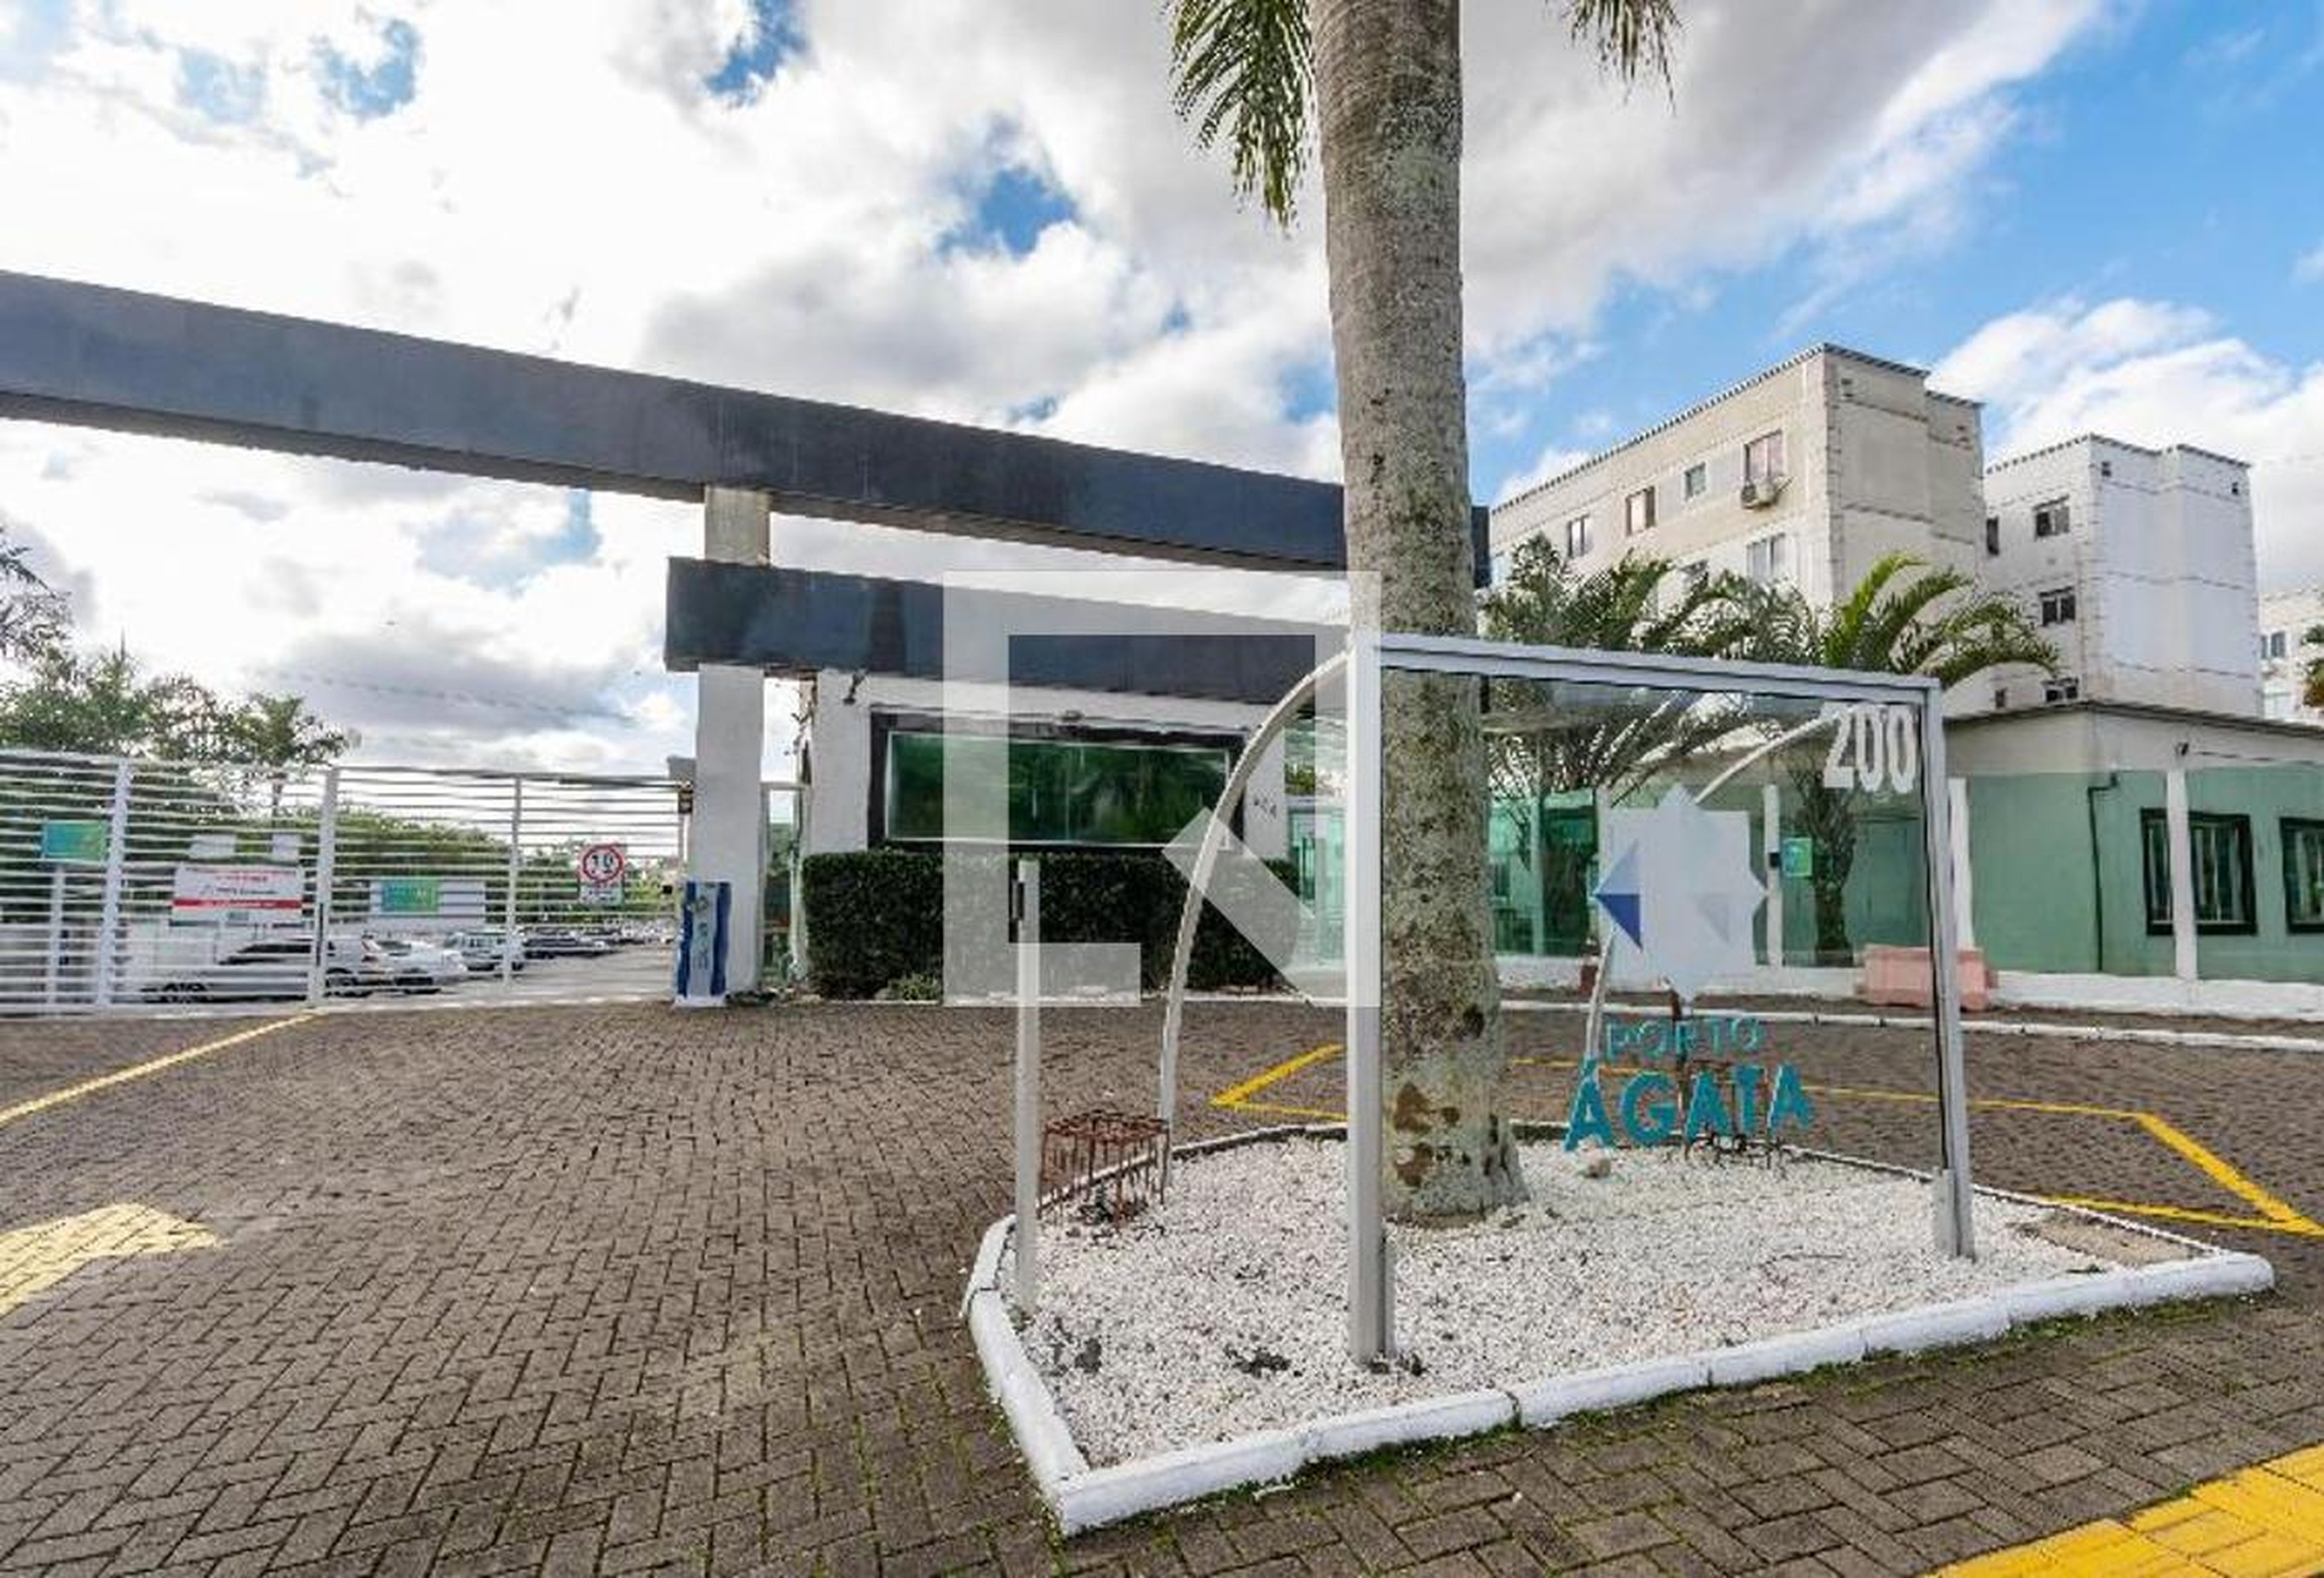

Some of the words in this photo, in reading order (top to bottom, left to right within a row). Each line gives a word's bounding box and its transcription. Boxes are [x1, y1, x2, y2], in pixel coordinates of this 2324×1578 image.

[1820, 702, 1919, 794] 200
[1606, 1017, 1765, 1061] PORTO
[1563, 1053, 1811, 1151] ÁGATA
